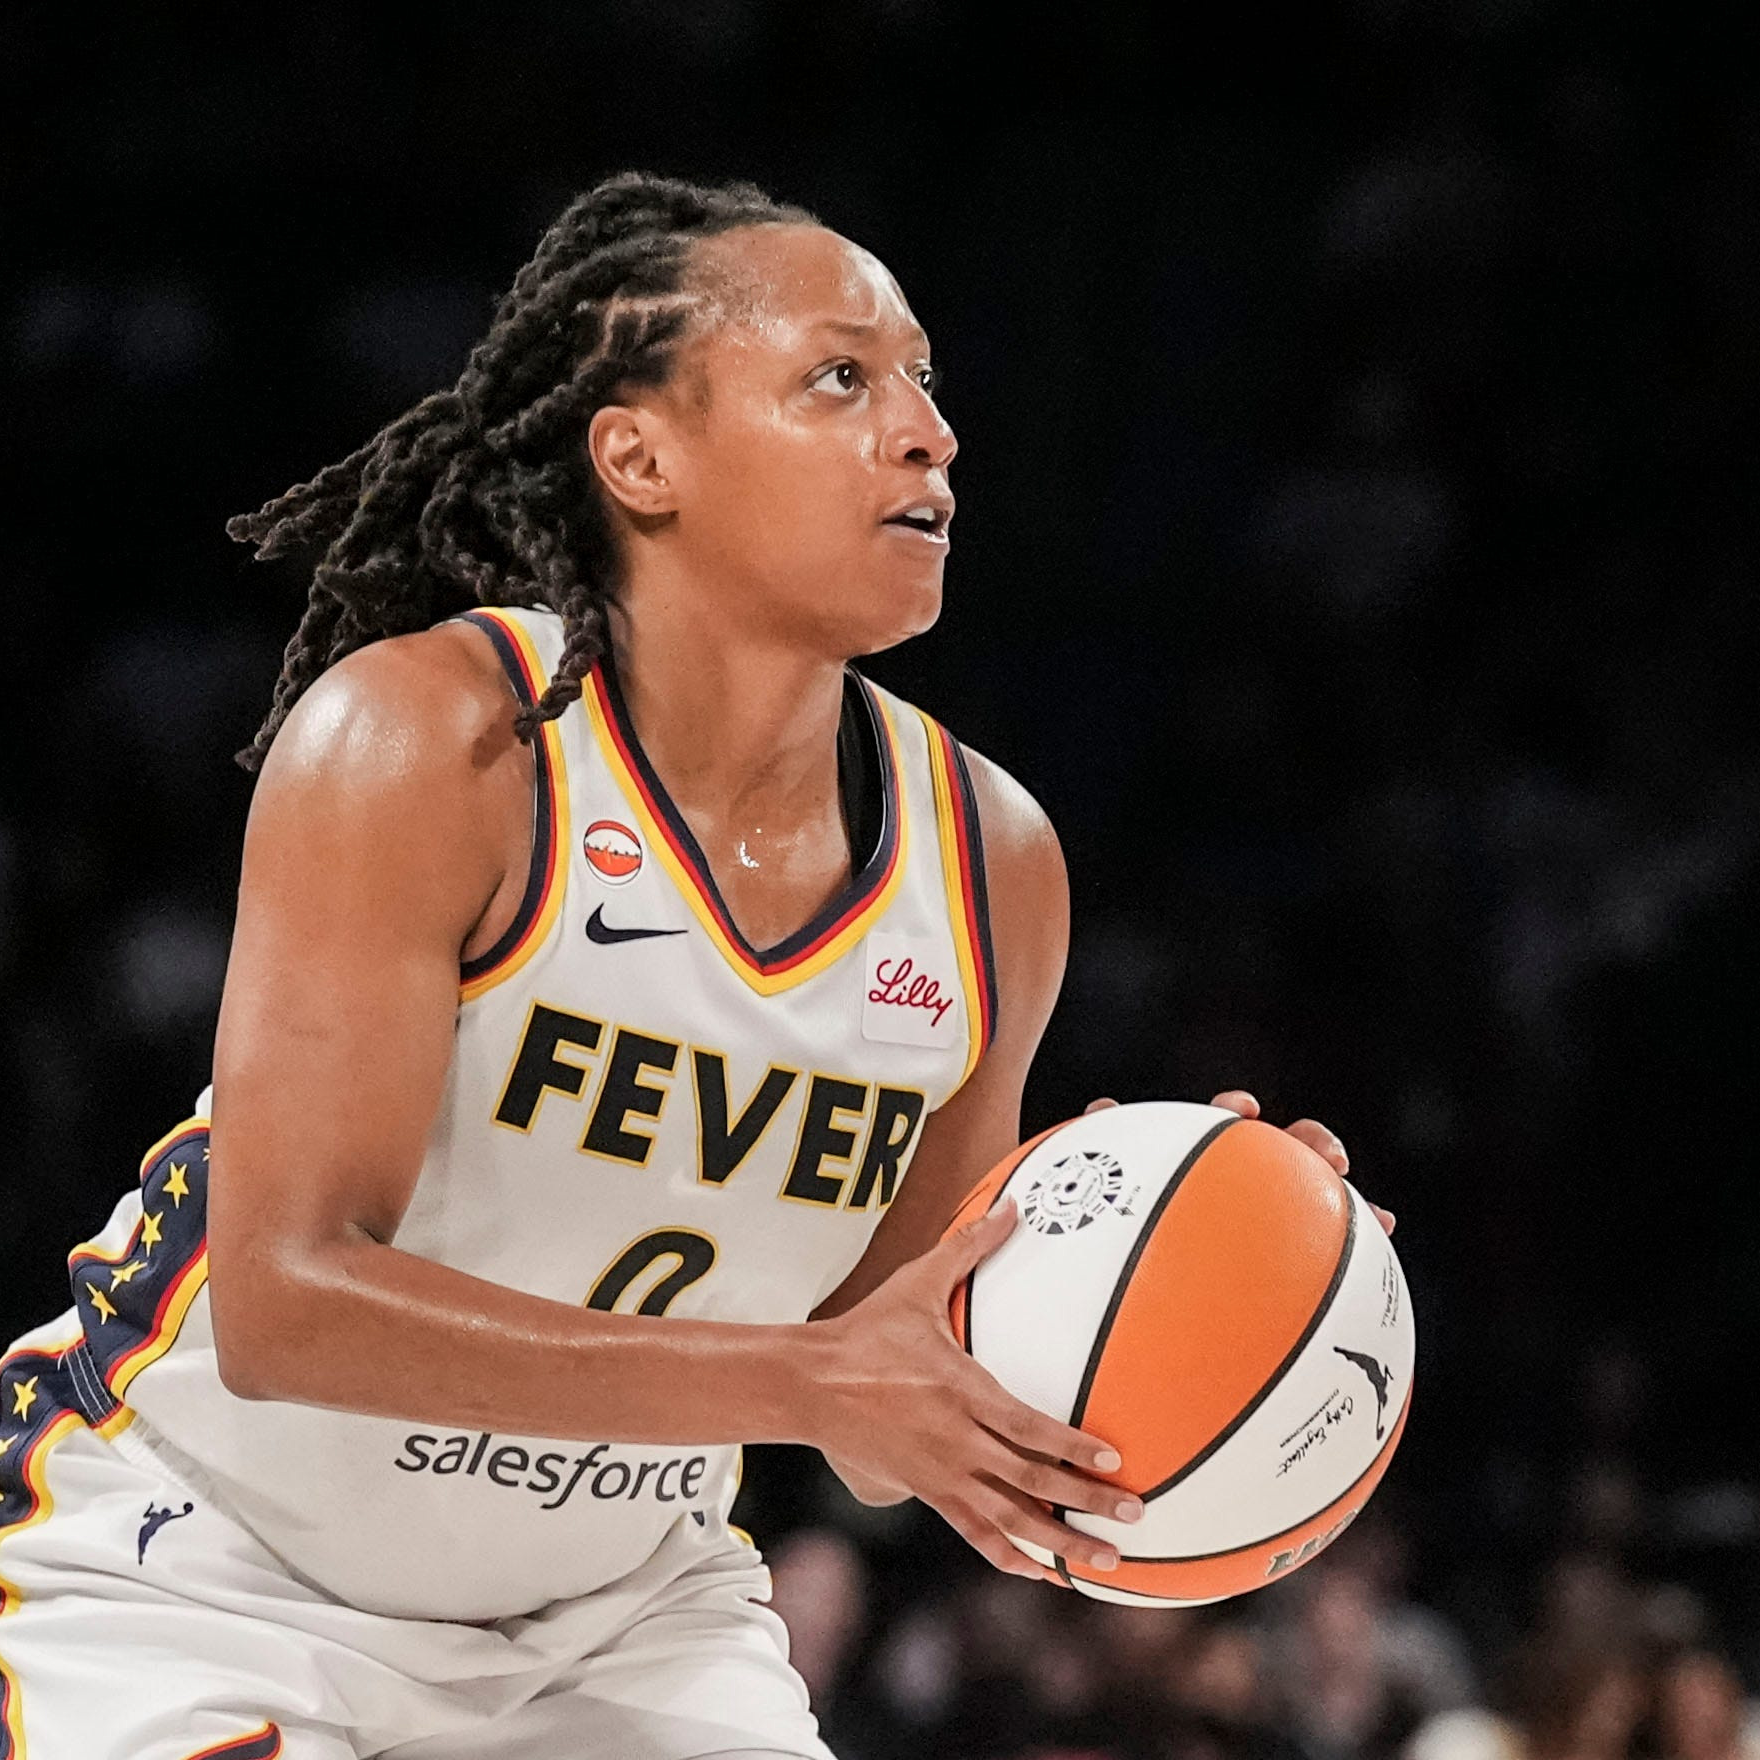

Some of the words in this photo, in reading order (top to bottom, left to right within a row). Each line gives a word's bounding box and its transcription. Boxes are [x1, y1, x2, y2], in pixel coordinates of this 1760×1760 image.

[868, 957, 954, 1028] Lilly
[490, 999, 926, 1213] FEVER
[394, 1433, 707, 1510] salesforce
